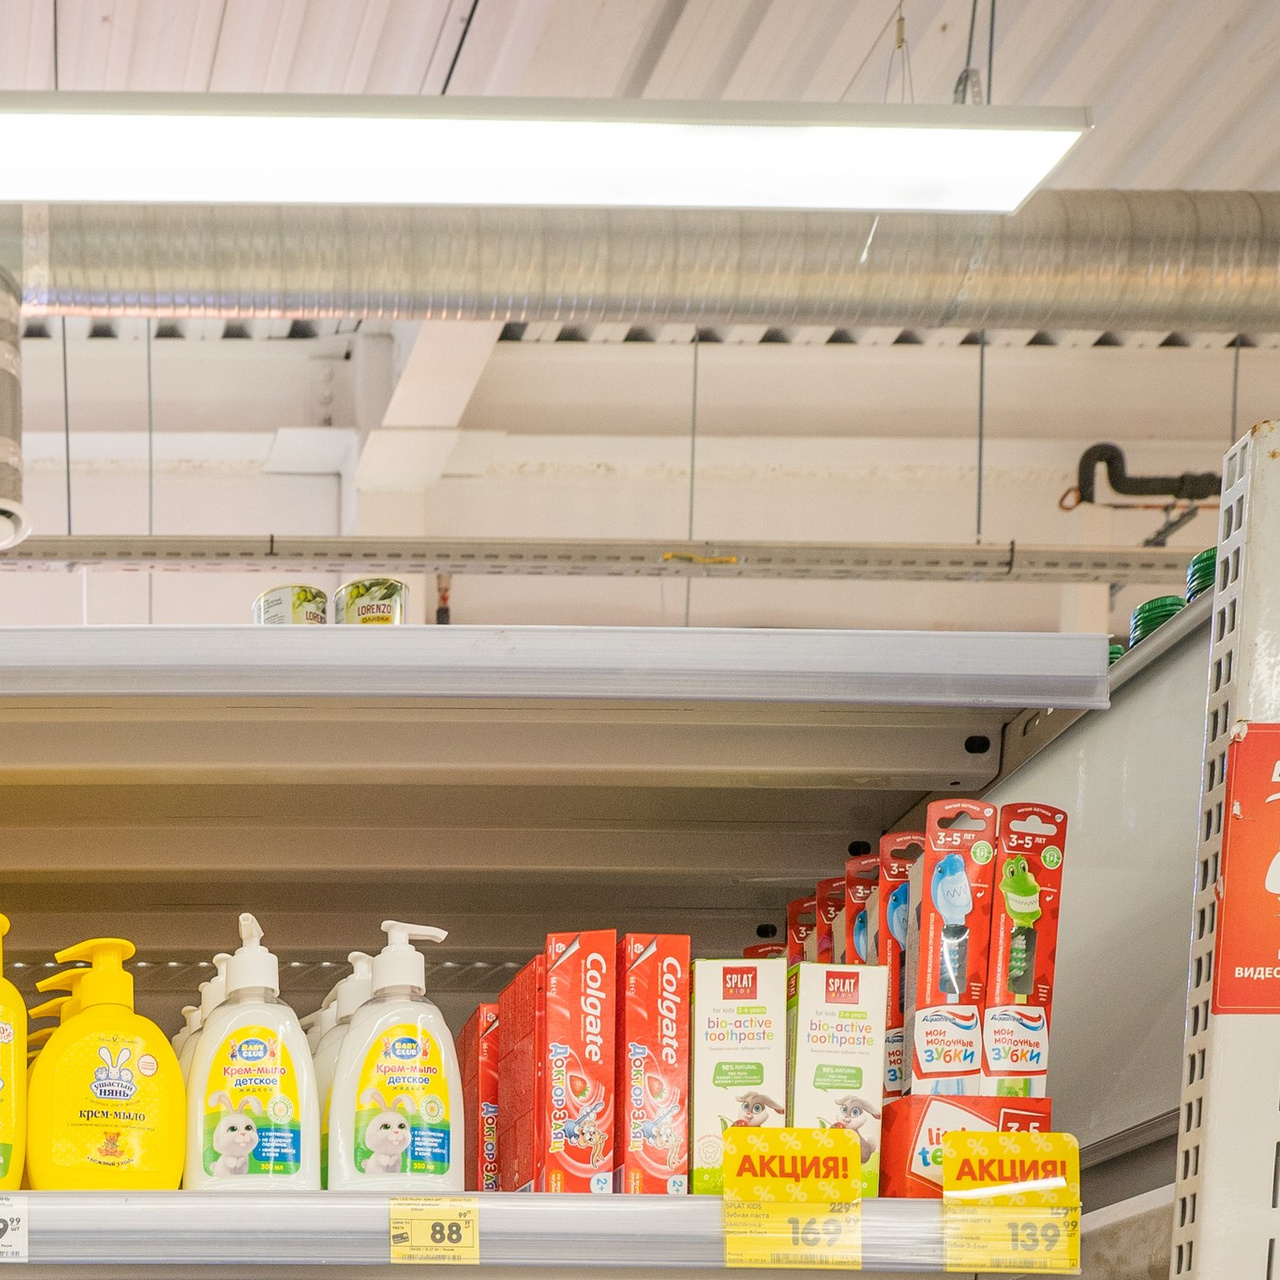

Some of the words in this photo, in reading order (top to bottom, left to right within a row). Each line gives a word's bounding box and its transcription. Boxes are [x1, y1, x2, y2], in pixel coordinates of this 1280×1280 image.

[358, 604, 392, 616] LORENZO
[937, 833, 960, 845] 3-5
[726, 974, 753, 988] SPLAT
[581, 953, 607, 1062] Colgate
[708, 1018, 771, 1029] bio-active
[705, 1030, 774, 1043] toothpaste
[223, 1065, 286, 1076] Крем-мыло
[235, 1077, 277, 1086] детское
[79, 1109, 145, 1123] крем-мыло
[737, 1154, 848, 1181] АКЦИЯ!
[956, 1160, 1066, 1183] АКЦИЯ!
[431, 1223, 462, 1244] 88
[788, 1217, 842, 1246] 169
[1008, 1222, 1061, 1251] 139
[1062, 1221, 1078, 1231] 99
